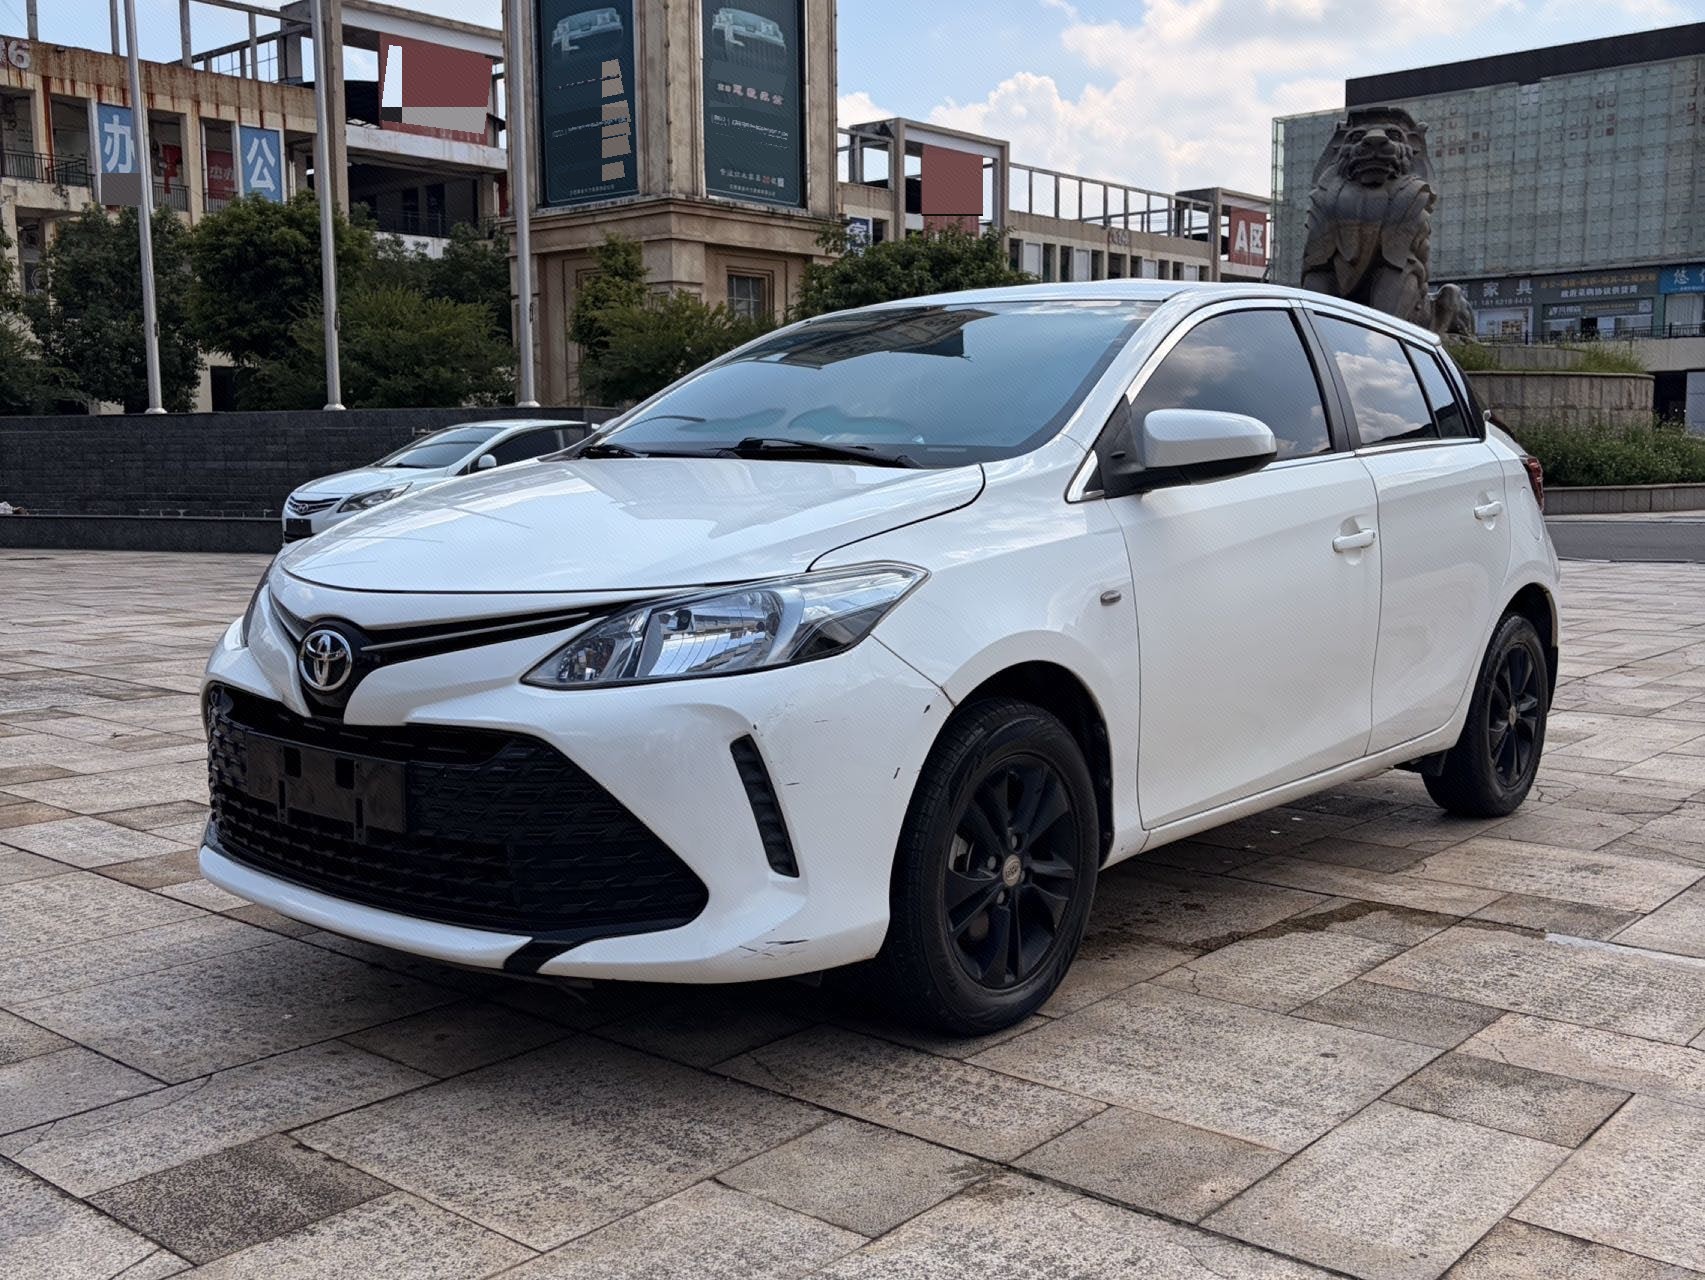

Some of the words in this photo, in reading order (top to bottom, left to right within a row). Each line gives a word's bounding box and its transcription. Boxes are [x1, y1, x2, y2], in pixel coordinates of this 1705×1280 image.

[104, 114, 136, 174] 办
[246, 137, 276, 193] 公
[1234, 219, 1264, 255] A区
